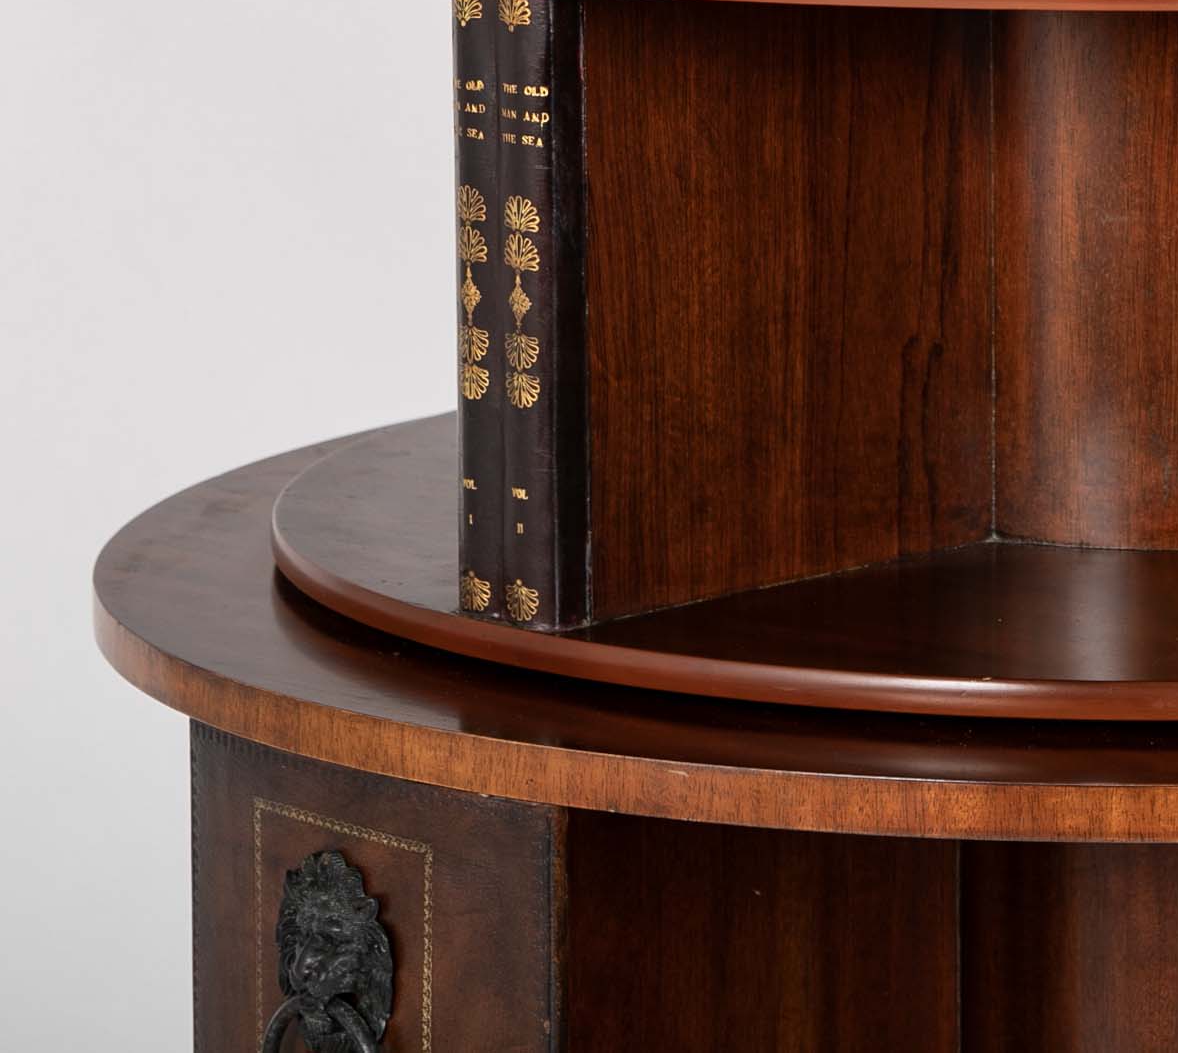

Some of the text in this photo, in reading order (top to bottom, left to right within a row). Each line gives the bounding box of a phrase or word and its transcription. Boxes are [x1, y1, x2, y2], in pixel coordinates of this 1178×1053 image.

[502, 83, 549, 97] THE OLD
[464, 103, 486, 114] AND
[466, 128, 486, 140] SEA
[502, 133, 544, 148] THE SEA
